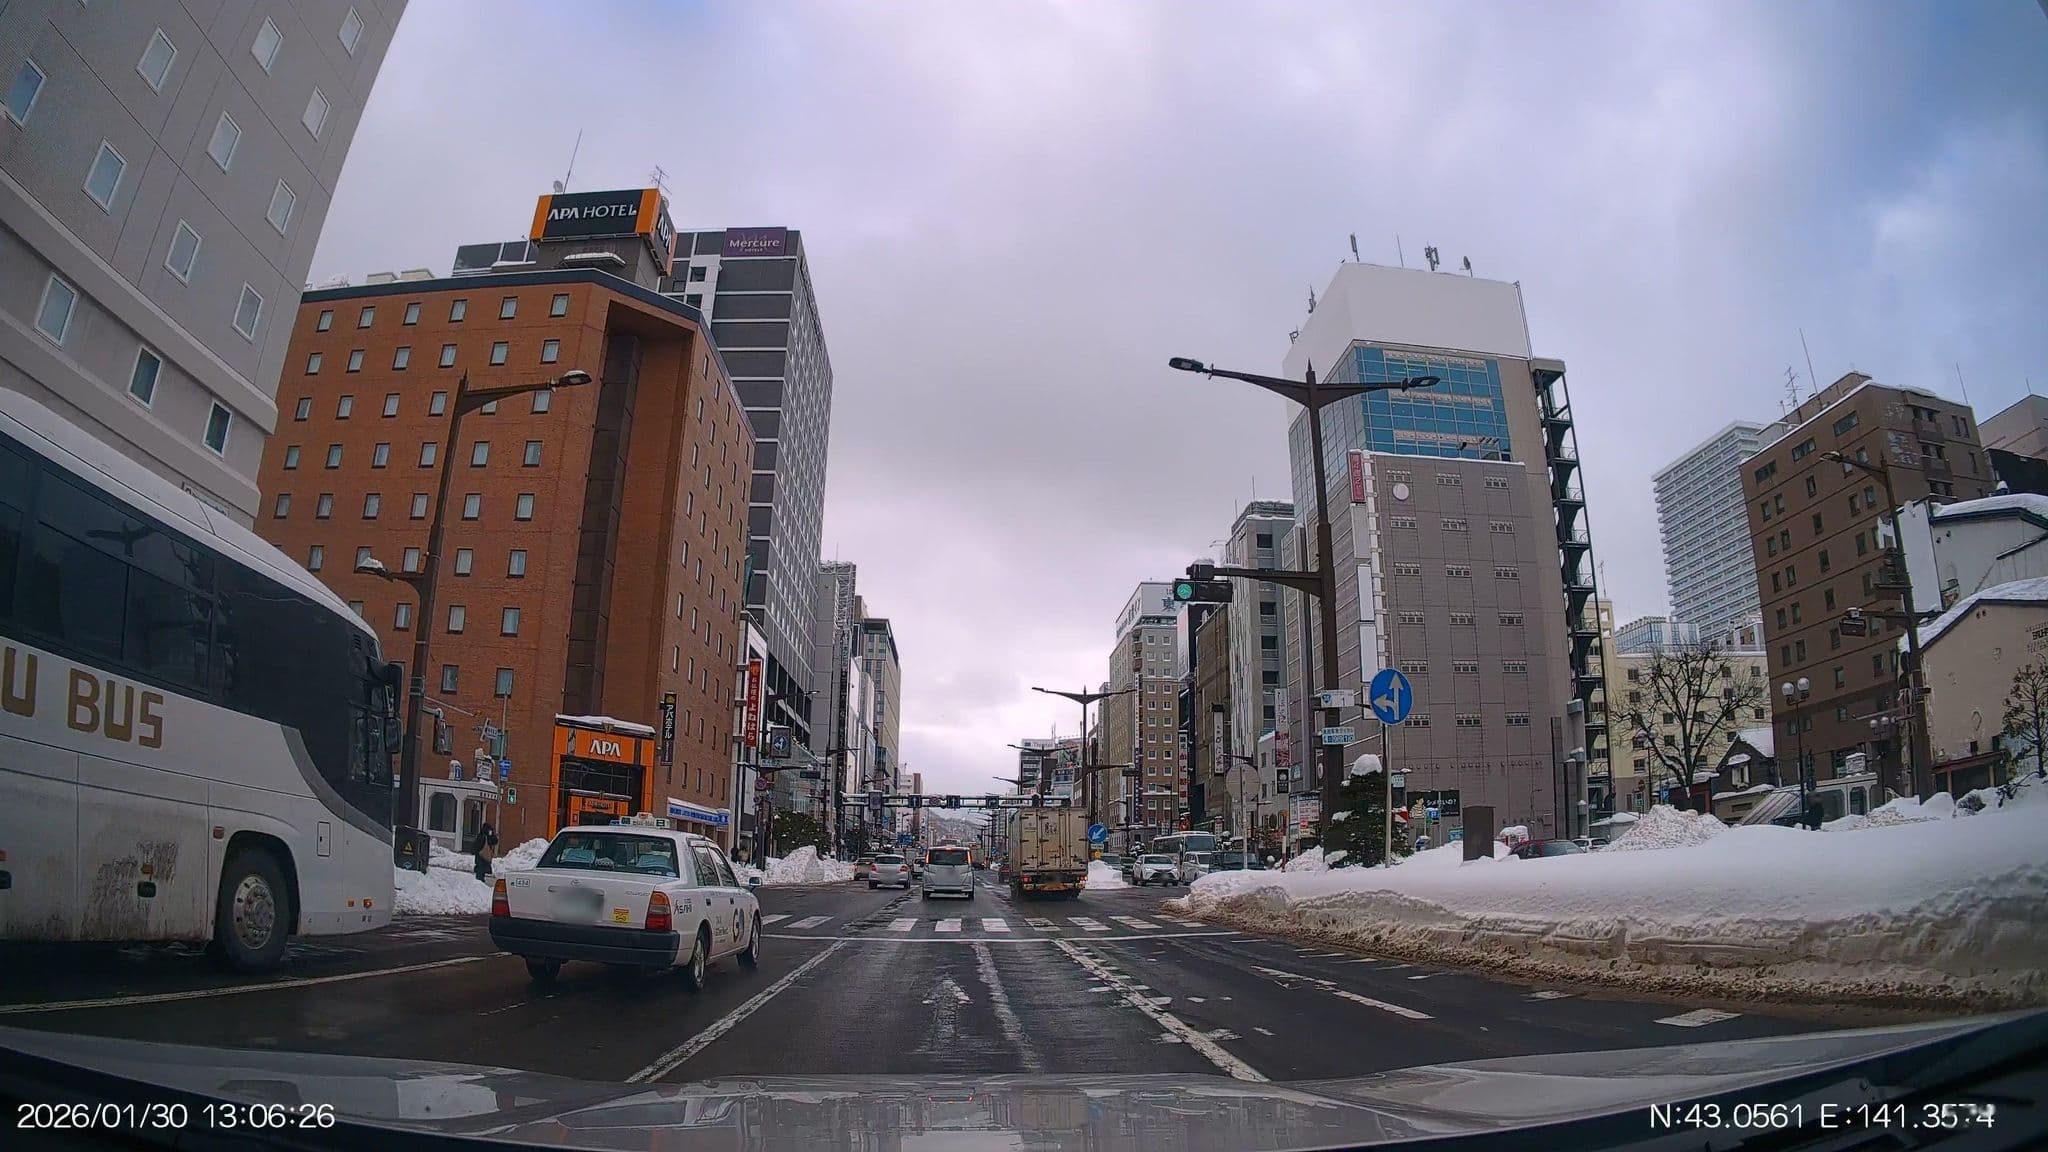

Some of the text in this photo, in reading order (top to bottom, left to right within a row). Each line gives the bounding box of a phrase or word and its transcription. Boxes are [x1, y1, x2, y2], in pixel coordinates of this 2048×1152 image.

[548, 204, 637, 220] APA HOTEL
[657, 214, 672, 254] APA
[730, 239, 780, 247] Mercure
[67, 667, 164, 749] BUS
[664, 704, 674, 739] アパホテル
[590, 739, 621, 757] APA
